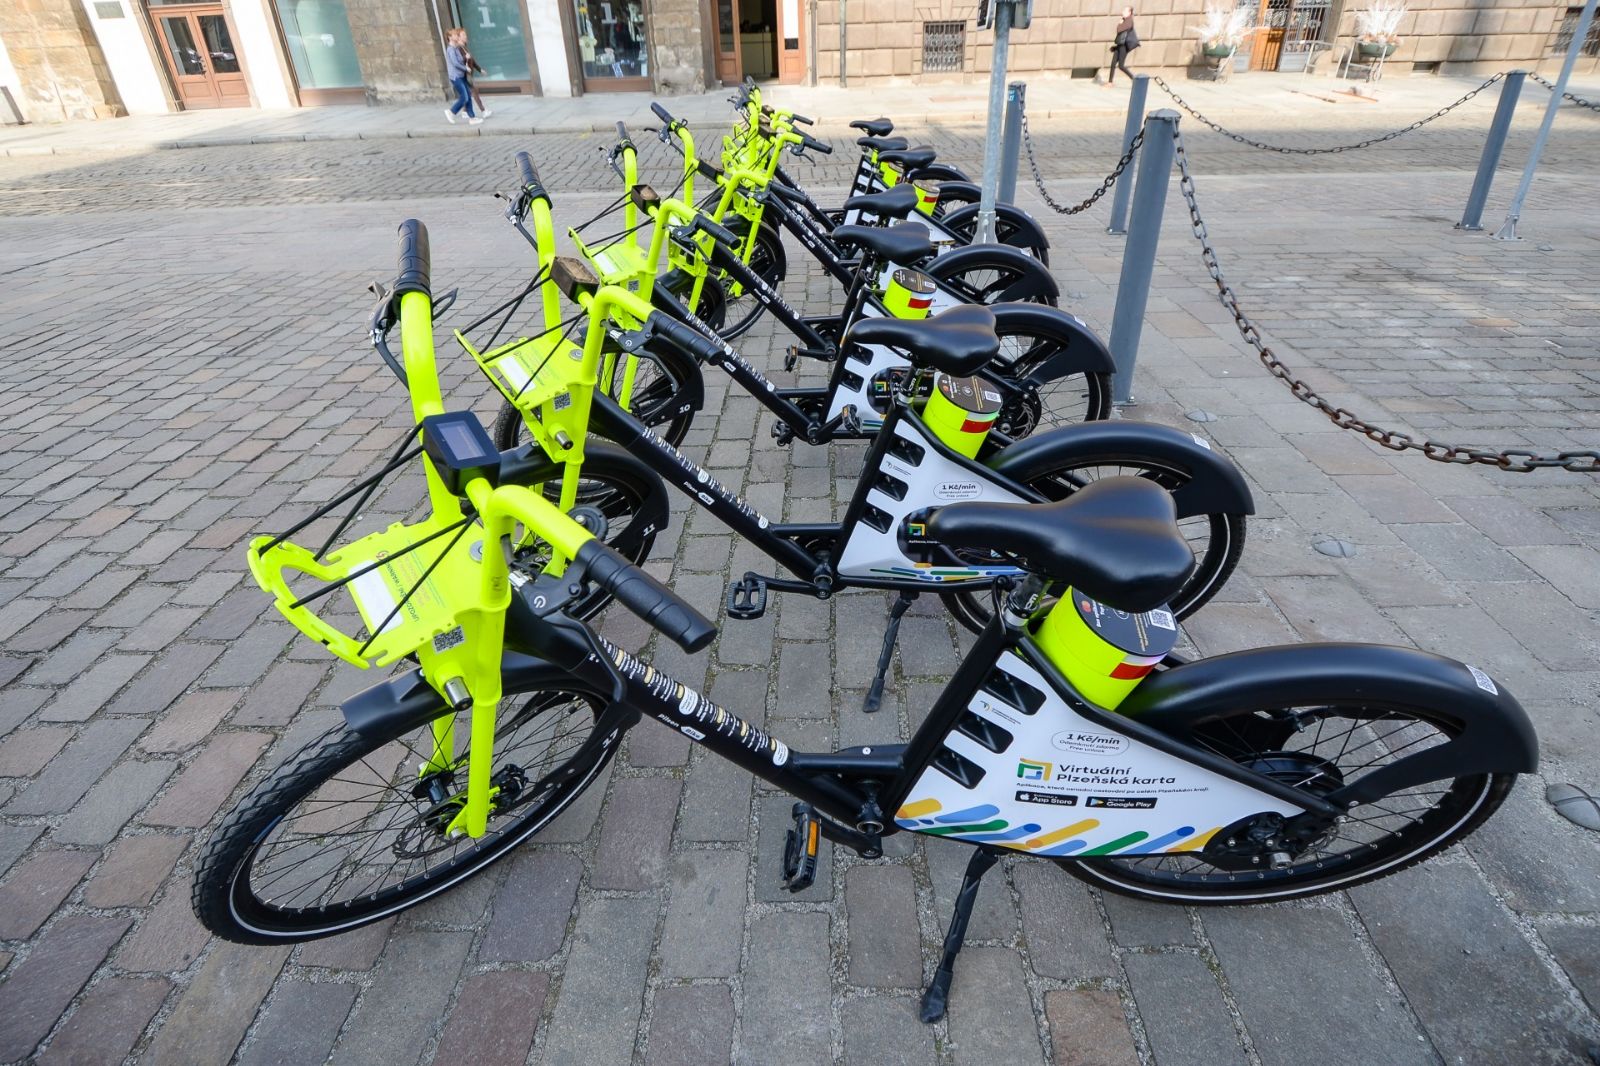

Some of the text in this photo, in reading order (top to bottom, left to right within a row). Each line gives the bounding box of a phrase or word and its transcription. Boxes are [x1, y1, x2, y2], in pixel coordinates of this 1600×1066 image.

[679, 404, 691, 414] 10
[1077, 734, 1120, 745] Kč/min
[1059, 764, 1132, 776] Virtuální
[1056, 773, 1176, 785] Plzeňská karta
[1032, 796, 1050, 804] App
[1050, 797, 1073, 805] Store
